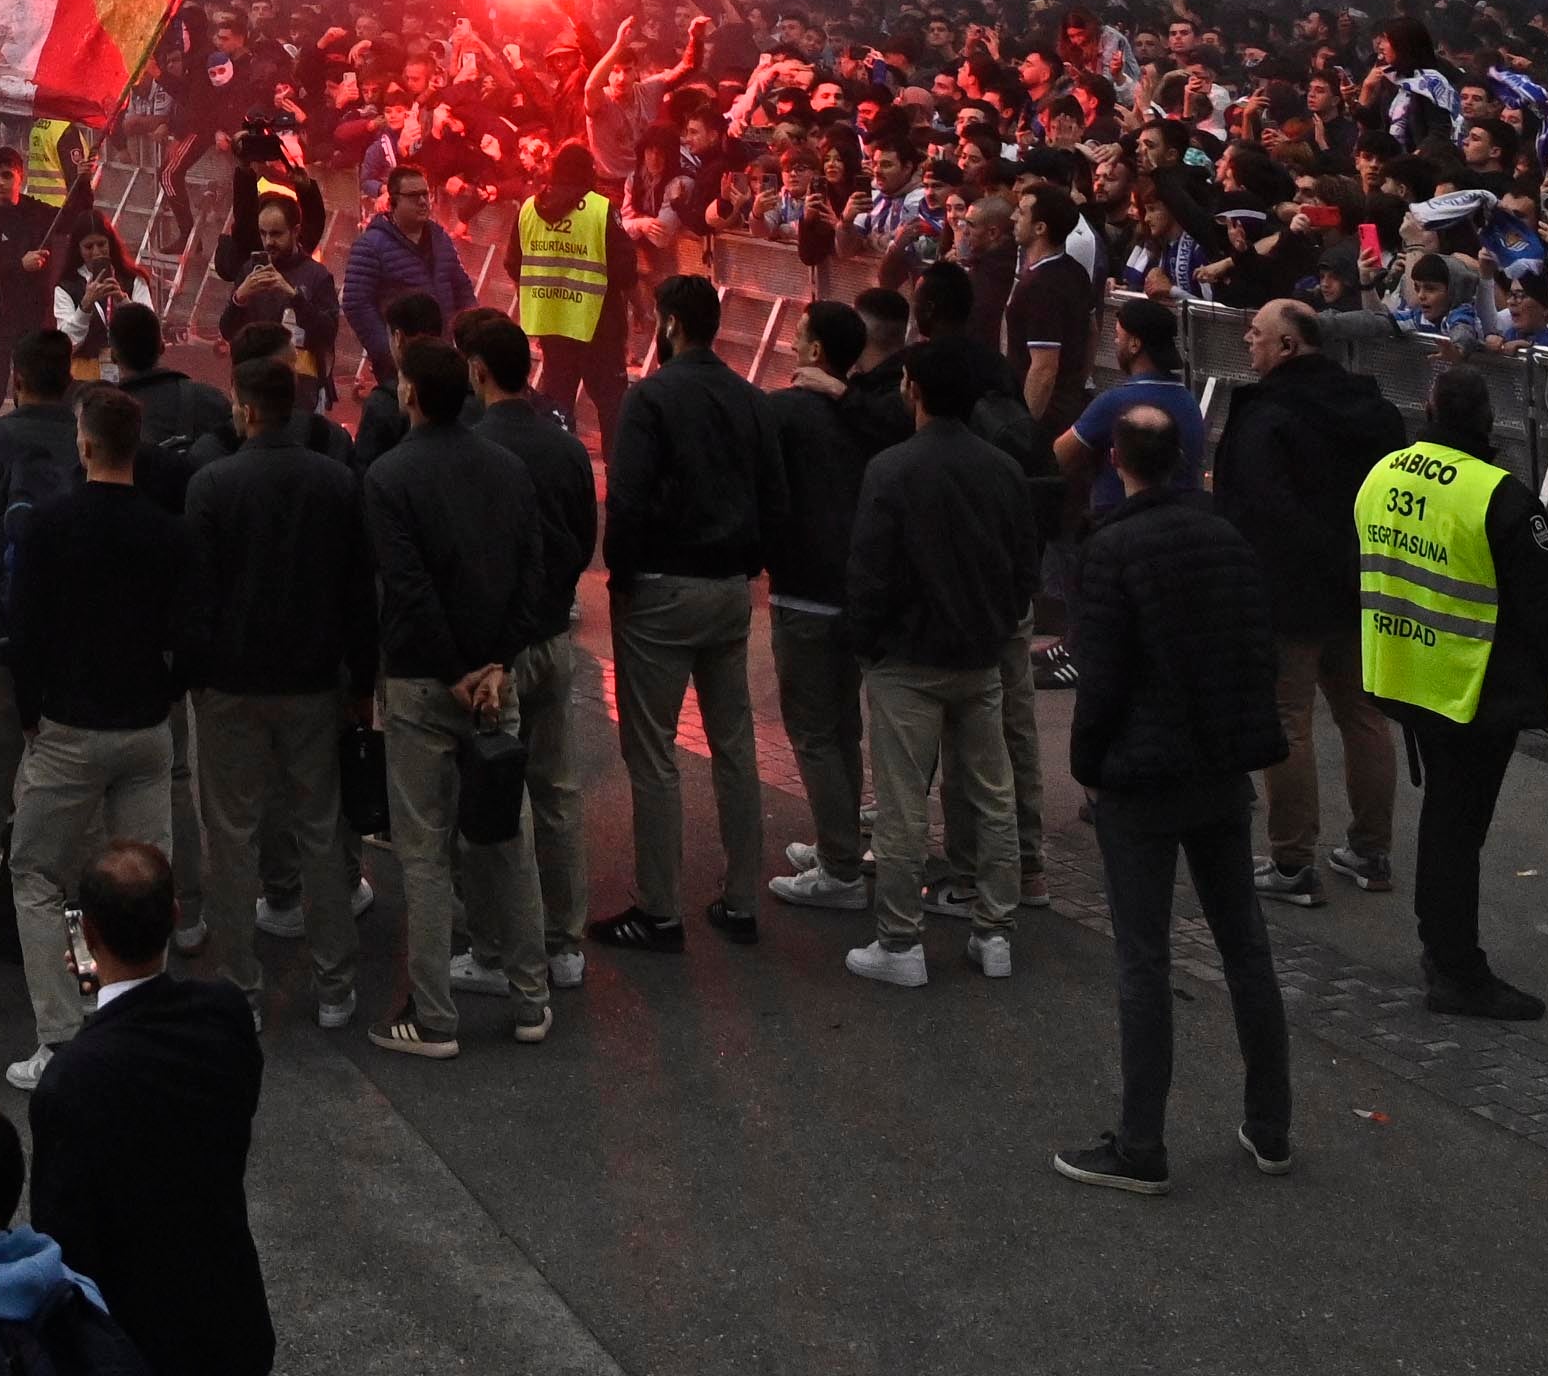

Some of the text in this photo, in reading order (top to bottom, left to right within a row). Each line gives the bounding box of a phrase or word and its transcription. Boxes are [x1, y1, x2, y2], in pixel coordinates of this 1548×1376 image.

[530, 240, 588, 256] SEGURTASUNA
[532, 287, 583, 303] SEGURIDAD
[1389, 452, 1458, 486] SABICO
[1386, 487, 1427, 521] 331
